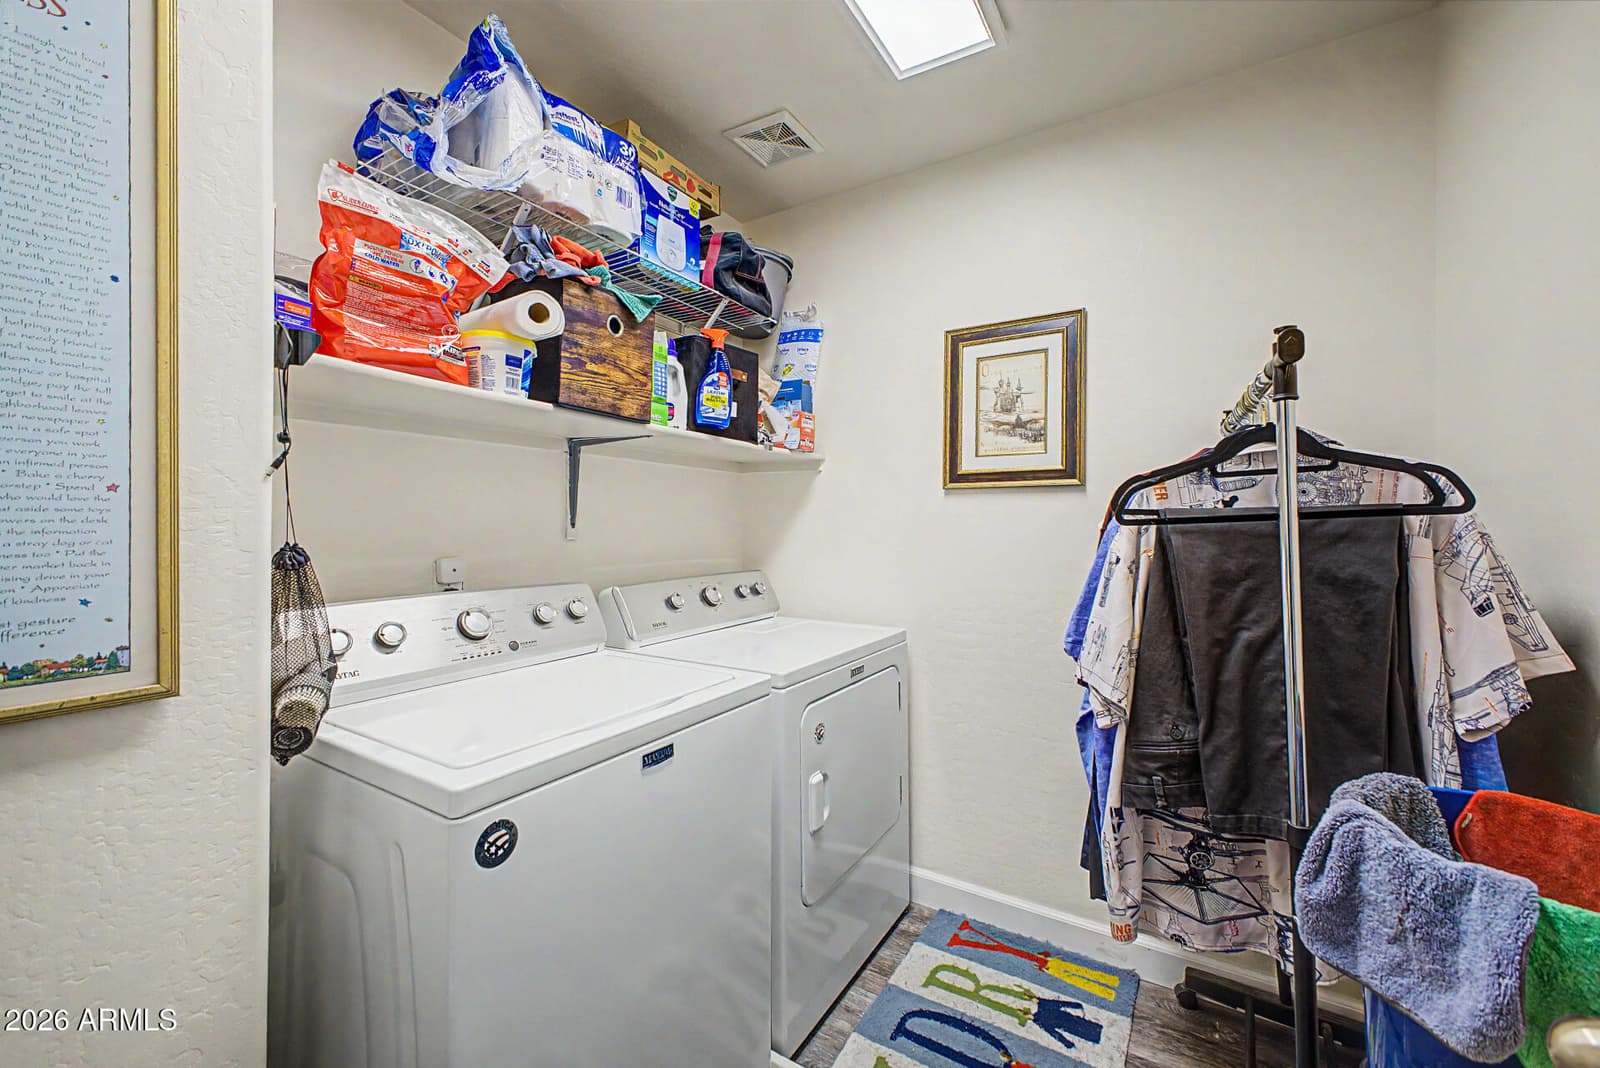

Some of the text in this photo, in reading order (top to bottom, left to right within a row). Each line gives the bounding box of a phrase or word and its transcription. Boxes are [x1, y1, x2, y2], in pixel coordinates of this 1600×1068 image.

[26, 113, 80, 137] shopping
[19, 124, 67, 144] parking
[364, 252, 380, 262] COLD
[380, 257, 400, 268] WATER
[5, 316, 50, 332] helping
[27, 346, 57, 354] work
[50, 358, 104, 372] homeless
[0, 365, 44, 375] ospice
[65, 372, 111, 384] hospital
[0, 389, 26, 398] rget
[0, 399, 67, 412] ghborhood
[22, 414, 90, 425] newspaper
[74, 430, 99, 438] spot
[46, 439, 101, 448] you work
[5, 448, 63, 457] everyone
[69, 463, 109, 472] person
[16, 469, 50, 478] Bake
[0, 482, 95, 492] orstep Spend
[26, 493, 63, 501] would
[66, 494, 90, 502] love
[94, 494, 110, 502] the
[59, 516, 76, 524] the
[7, 527, 97, 537] the information
[16, 539, 48, 548] stray
[52, 539, 75, 548] dog
[30, 584, 101, 593] Appreciate
[12, 596, 66, 605] kindness
[17, 617, 77, 630] gesture
[0, 628, 66, 643] fference
[336, 670, 360, 680] YTAG
